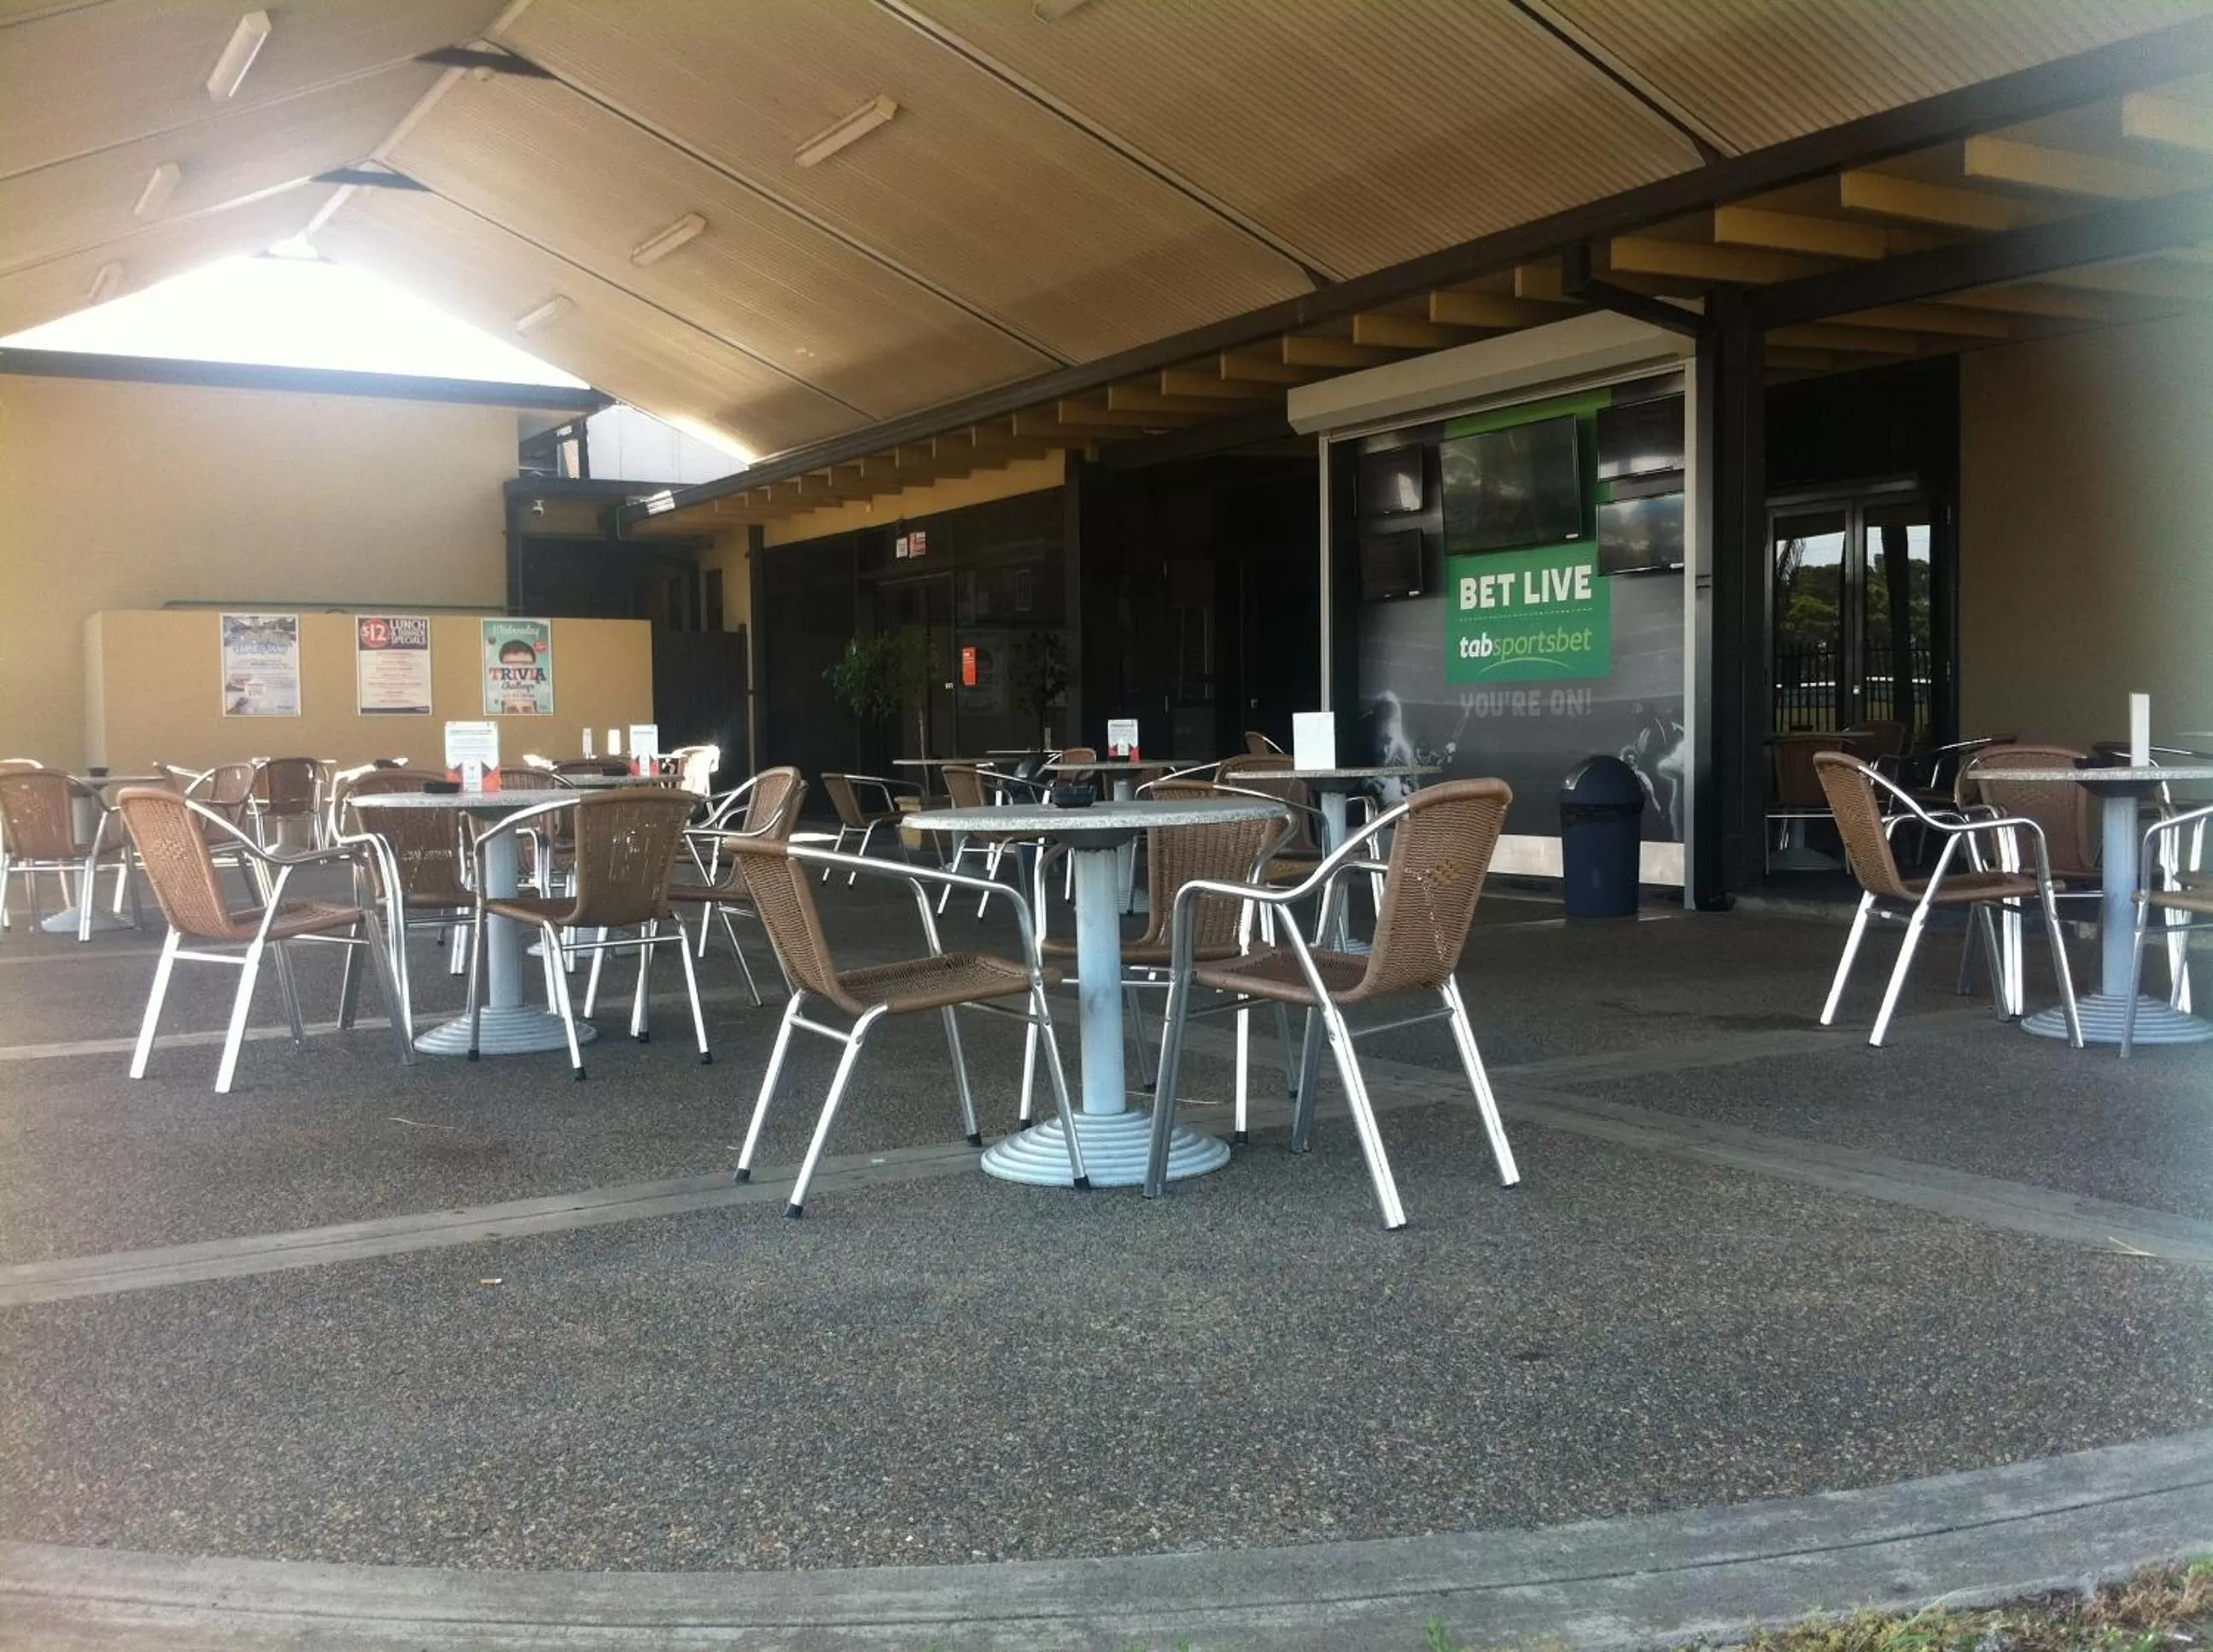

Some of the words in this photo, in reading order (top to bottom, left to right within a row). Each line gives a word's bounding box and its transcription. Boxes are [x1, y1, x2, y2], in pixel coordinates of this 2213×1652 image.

[1460, 573, 1515, 610] BET
[1524, 564, 1591, 604] LIVE
[360, 624, 386, 641] $12
[390, 618, 425, 629] LUNCH
[1459, 627, 1592, 660] tabsportsbet
[489, 668, 546, 682] TRIVIA
[1459, 691, 1540, 718] YOU'RE
[1550, 688, 1591, 716] ON!
